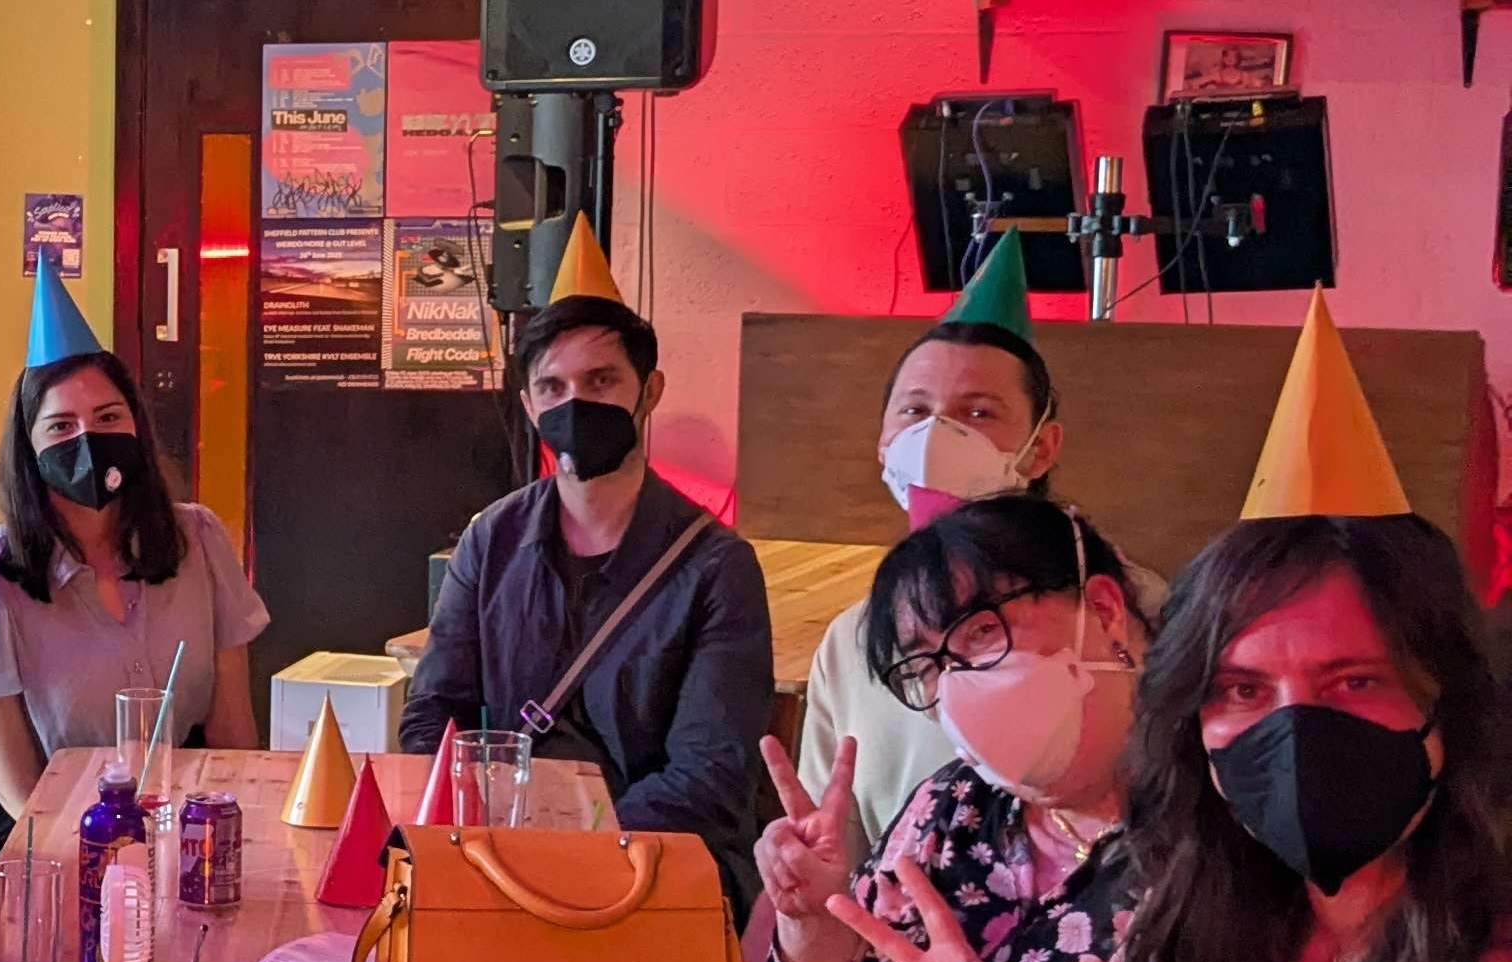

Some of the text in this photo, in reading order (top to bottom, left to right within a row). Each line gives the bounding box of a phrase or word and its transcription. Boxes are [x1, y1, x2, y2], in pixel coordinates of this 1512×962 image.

[272, 110, 346, 125] This June
[407, 302, 480, 321] NikNak
[406, 348, 480, 364] Flight Coda
